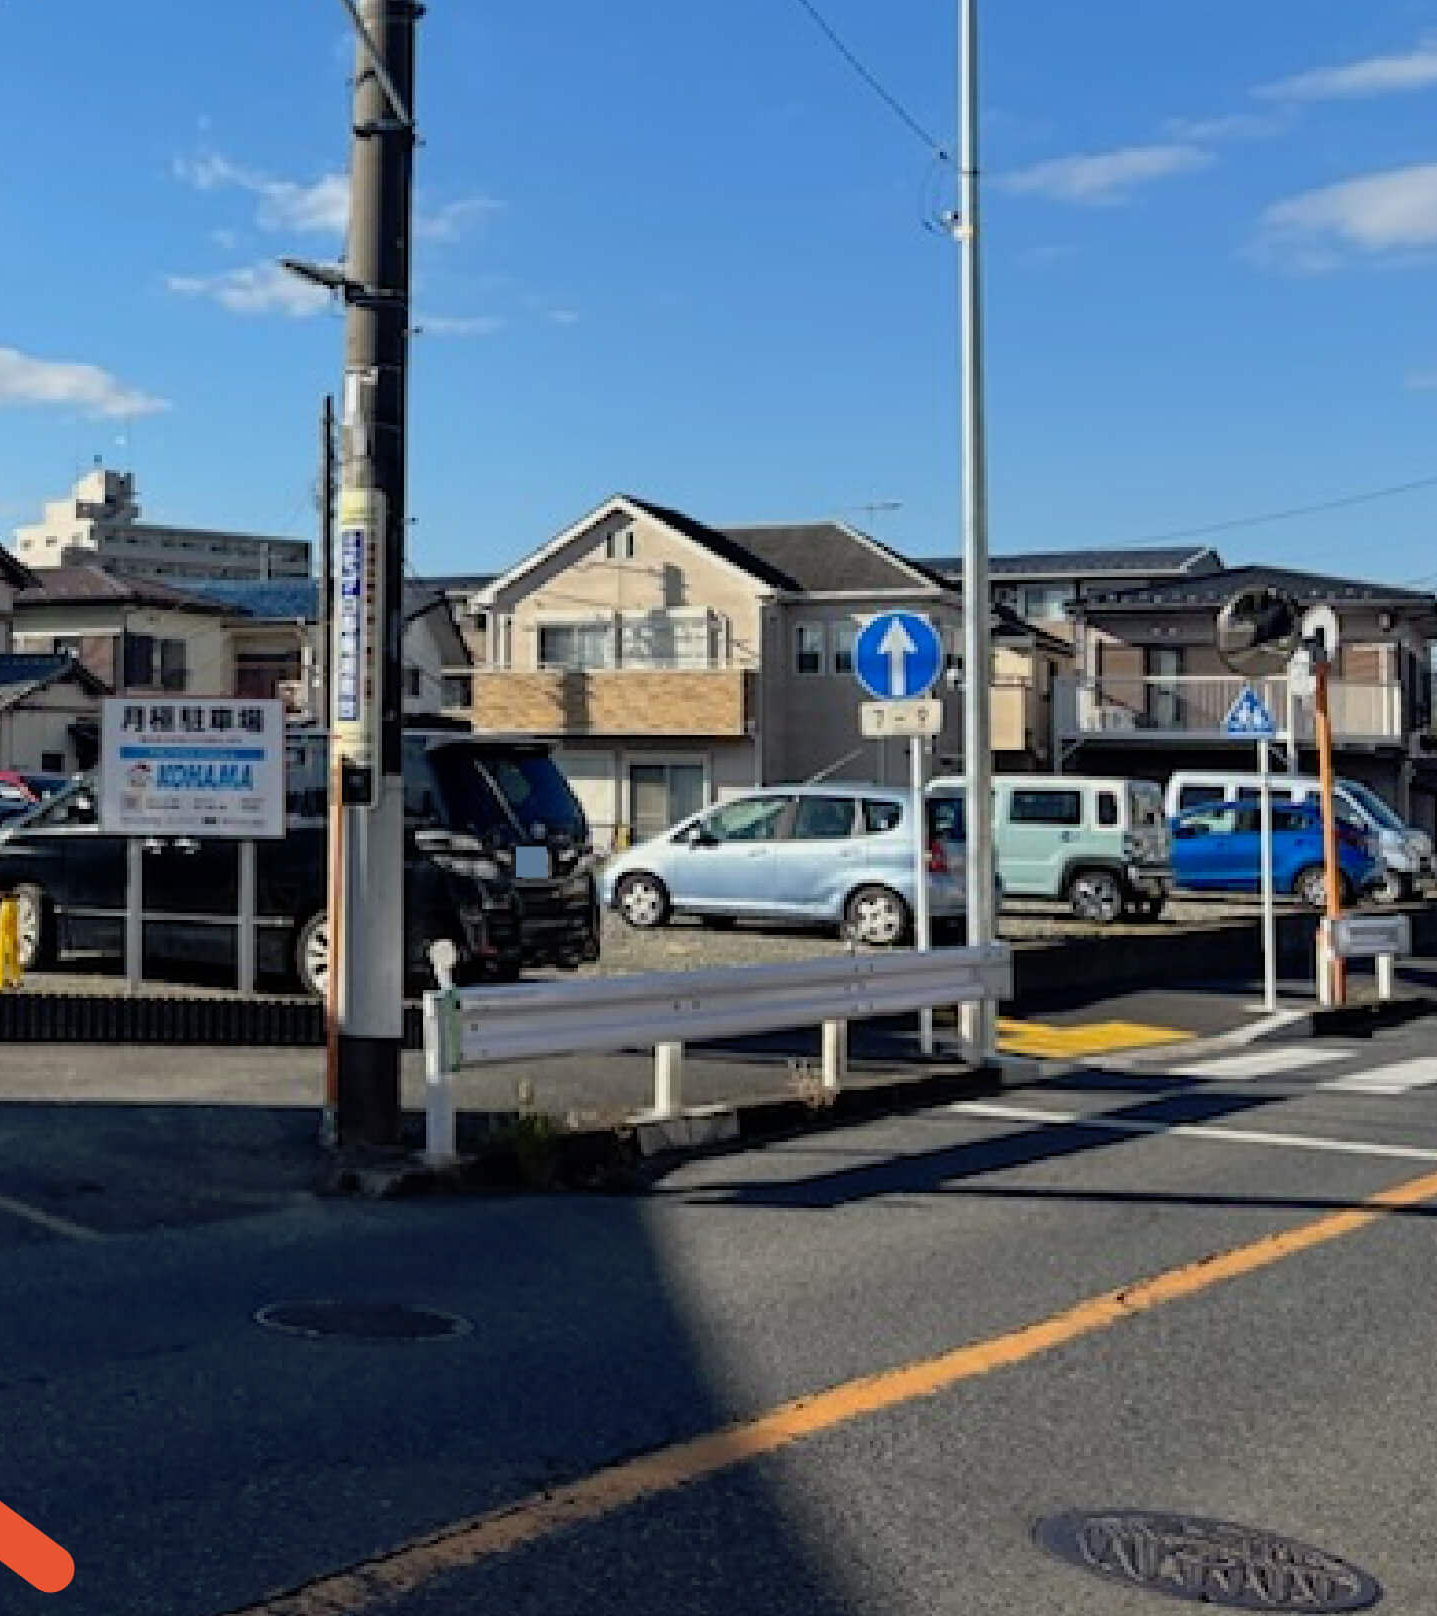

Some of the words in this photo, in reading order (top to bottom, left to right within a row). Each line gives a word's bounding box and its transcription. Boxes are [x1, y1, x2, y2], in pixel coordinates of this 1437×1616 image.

[122, 705, 263, 733] 月極駐車場
[157, 764, 254, 790] KOHAMA
